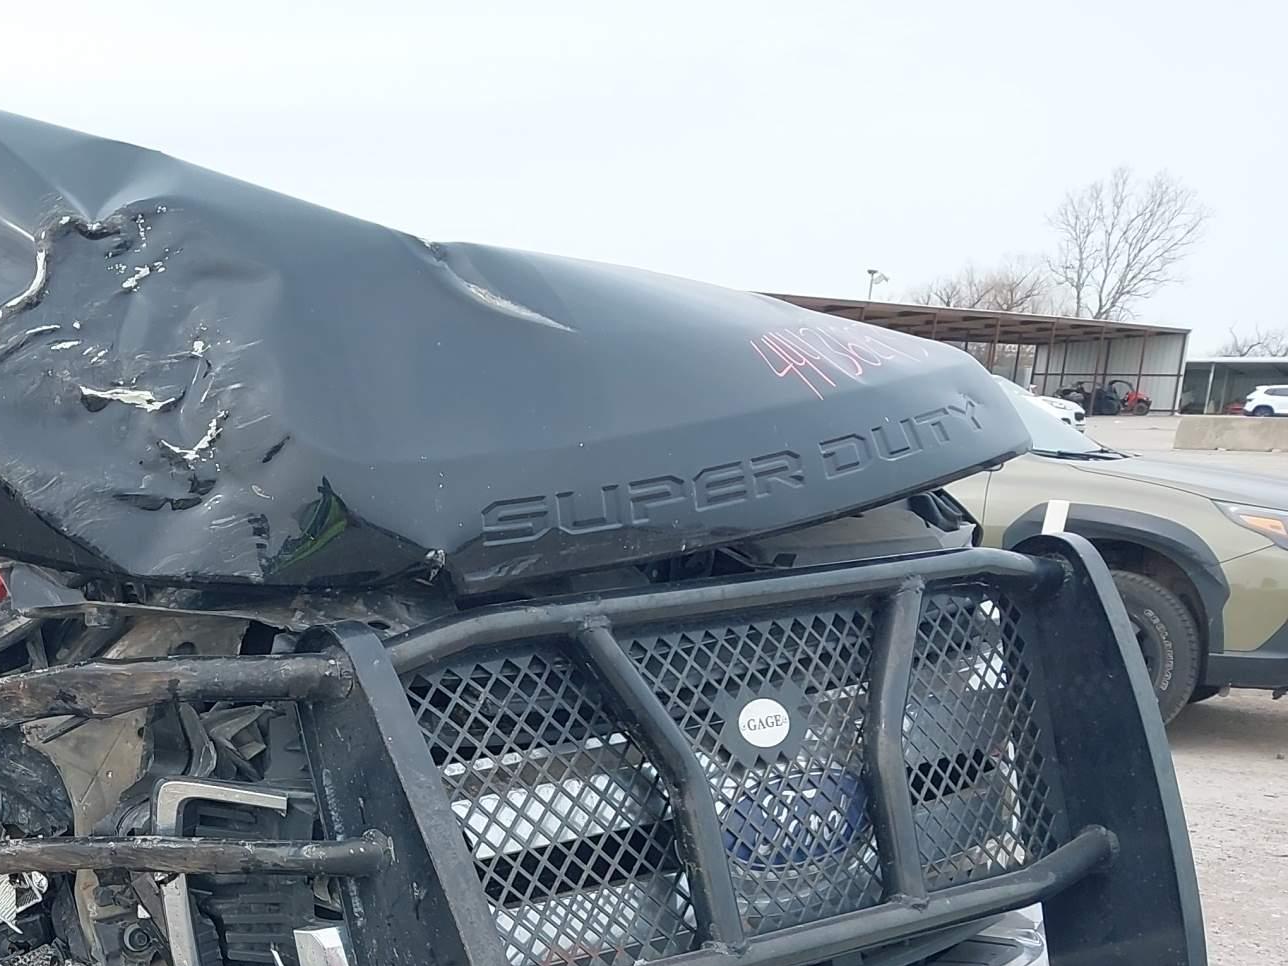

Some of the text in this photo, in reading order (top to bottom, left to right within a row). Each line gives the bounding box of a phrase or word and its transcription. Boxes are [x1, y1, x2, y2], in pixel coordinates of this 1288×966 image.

[480, 393, 983, 547] SUPER DUTY
[747, 714, 783, 731] GAGE
